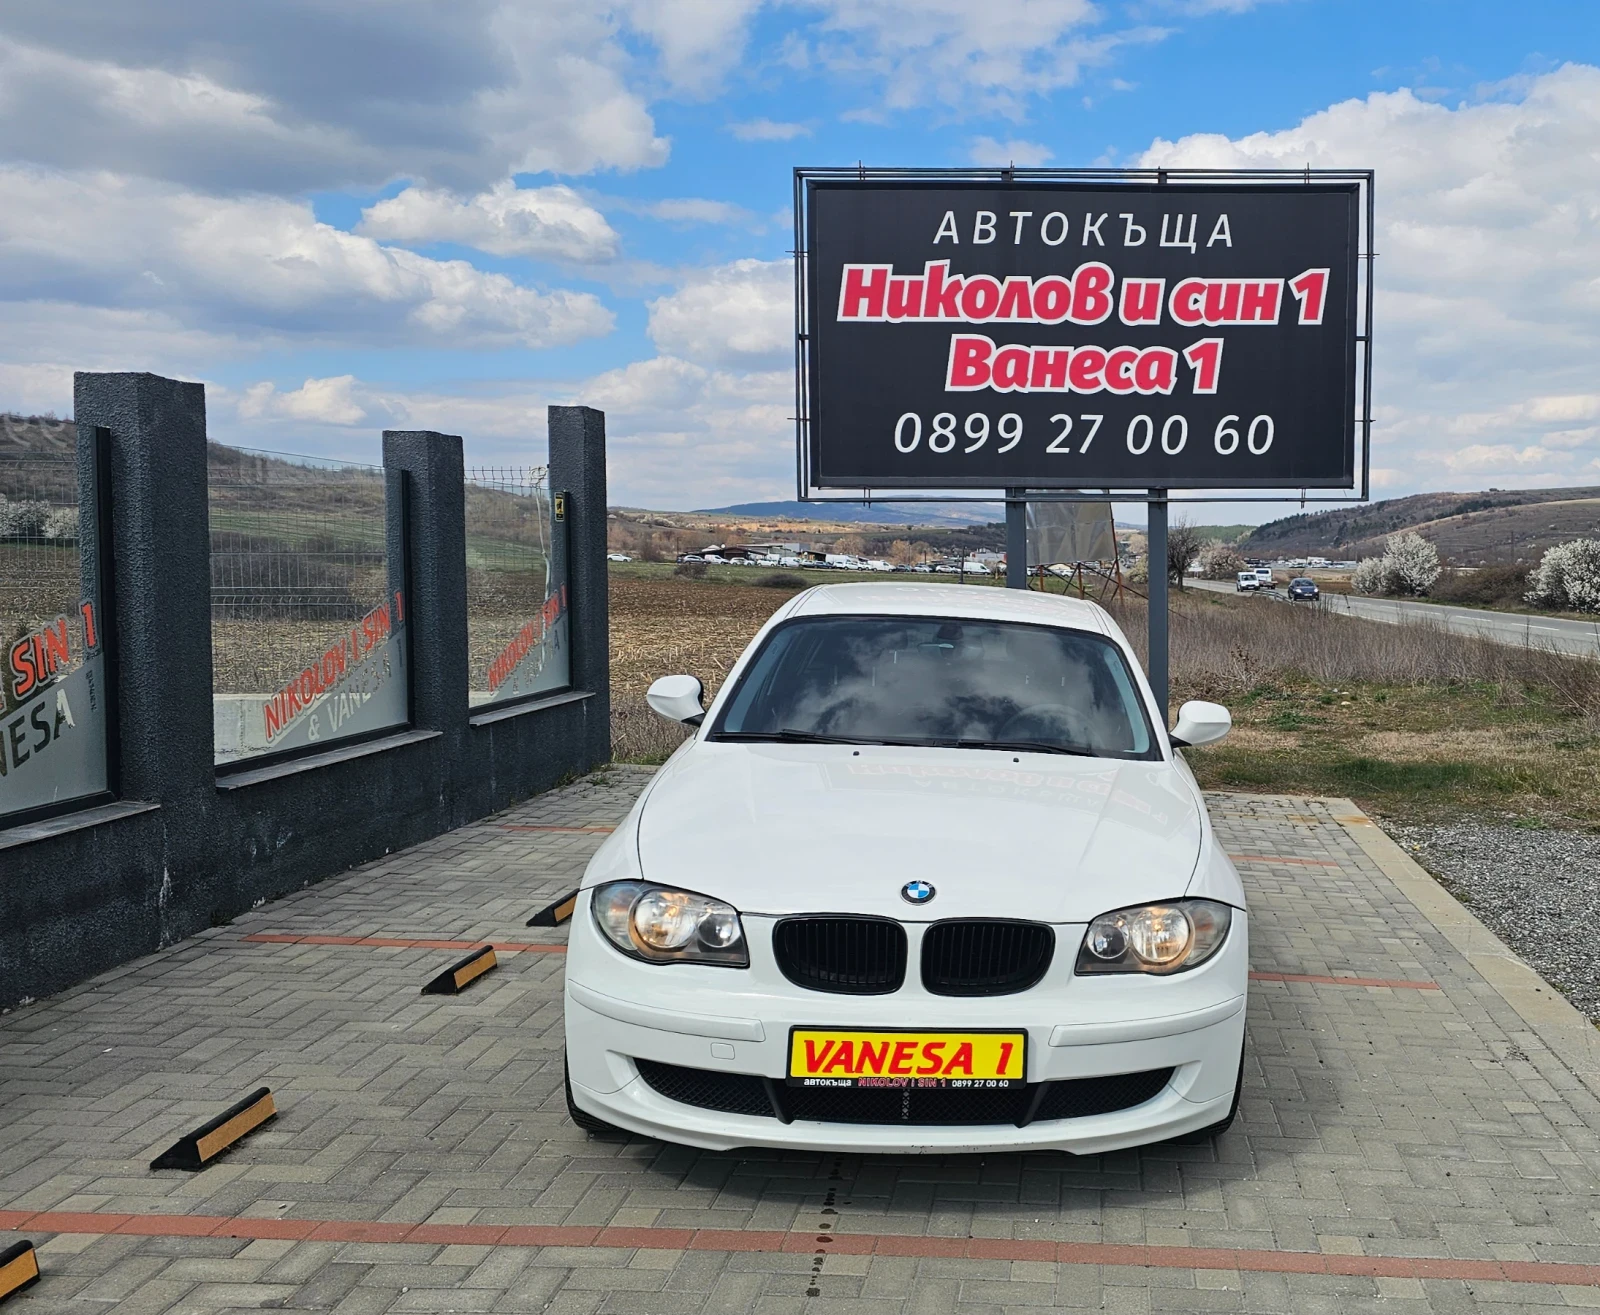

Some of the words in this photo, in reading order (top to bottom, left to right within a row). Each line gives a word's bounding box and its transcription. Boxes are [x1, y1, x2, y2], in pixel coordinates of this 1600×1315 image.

[933, 210, 1233, 254] АВТОКЪЩА
[837, 259, 1114, 326] Николов
[1119, 277, 1166, 325] и
[1169, 277, 1285, 326] син
[1289, 267, 1330, 325] 1
[944, 334, 1178, 395] Ванеса
[1183, 337, 1225, 394] 1
[894, 412, 1024, 455] 0899
[1045, 413, 1104, 454] 27
[1126, 413, 1189, 456] 00
[1213, 413, 1275, 456] 60
[11, 617, 70, 696] SIN
[81, 602, 98, 649] 1
[263, 638, 346, 740] NIKOLOV
[351, 629, 360, 661] I
[362, 602, 391, 652] SIN
[307, 713, 320, 741] &
[804, 1040, 974, 1075] VANESA
[996, 1042, 1014, 1075] 1
[803, 1077, 852, 1087] автокъща
[857, 1077, 909, 1088] NIKOLOV
[917, 1078, 937, 1088] SIN
[940, 1078, 947, 1088] 1
[951, 1080, 972, 1088] 0899
[973, 1080, 985, 1088] 27
[985, 1080, 997, 1088] 00
[998, 1080, 1009, 1088] 60
